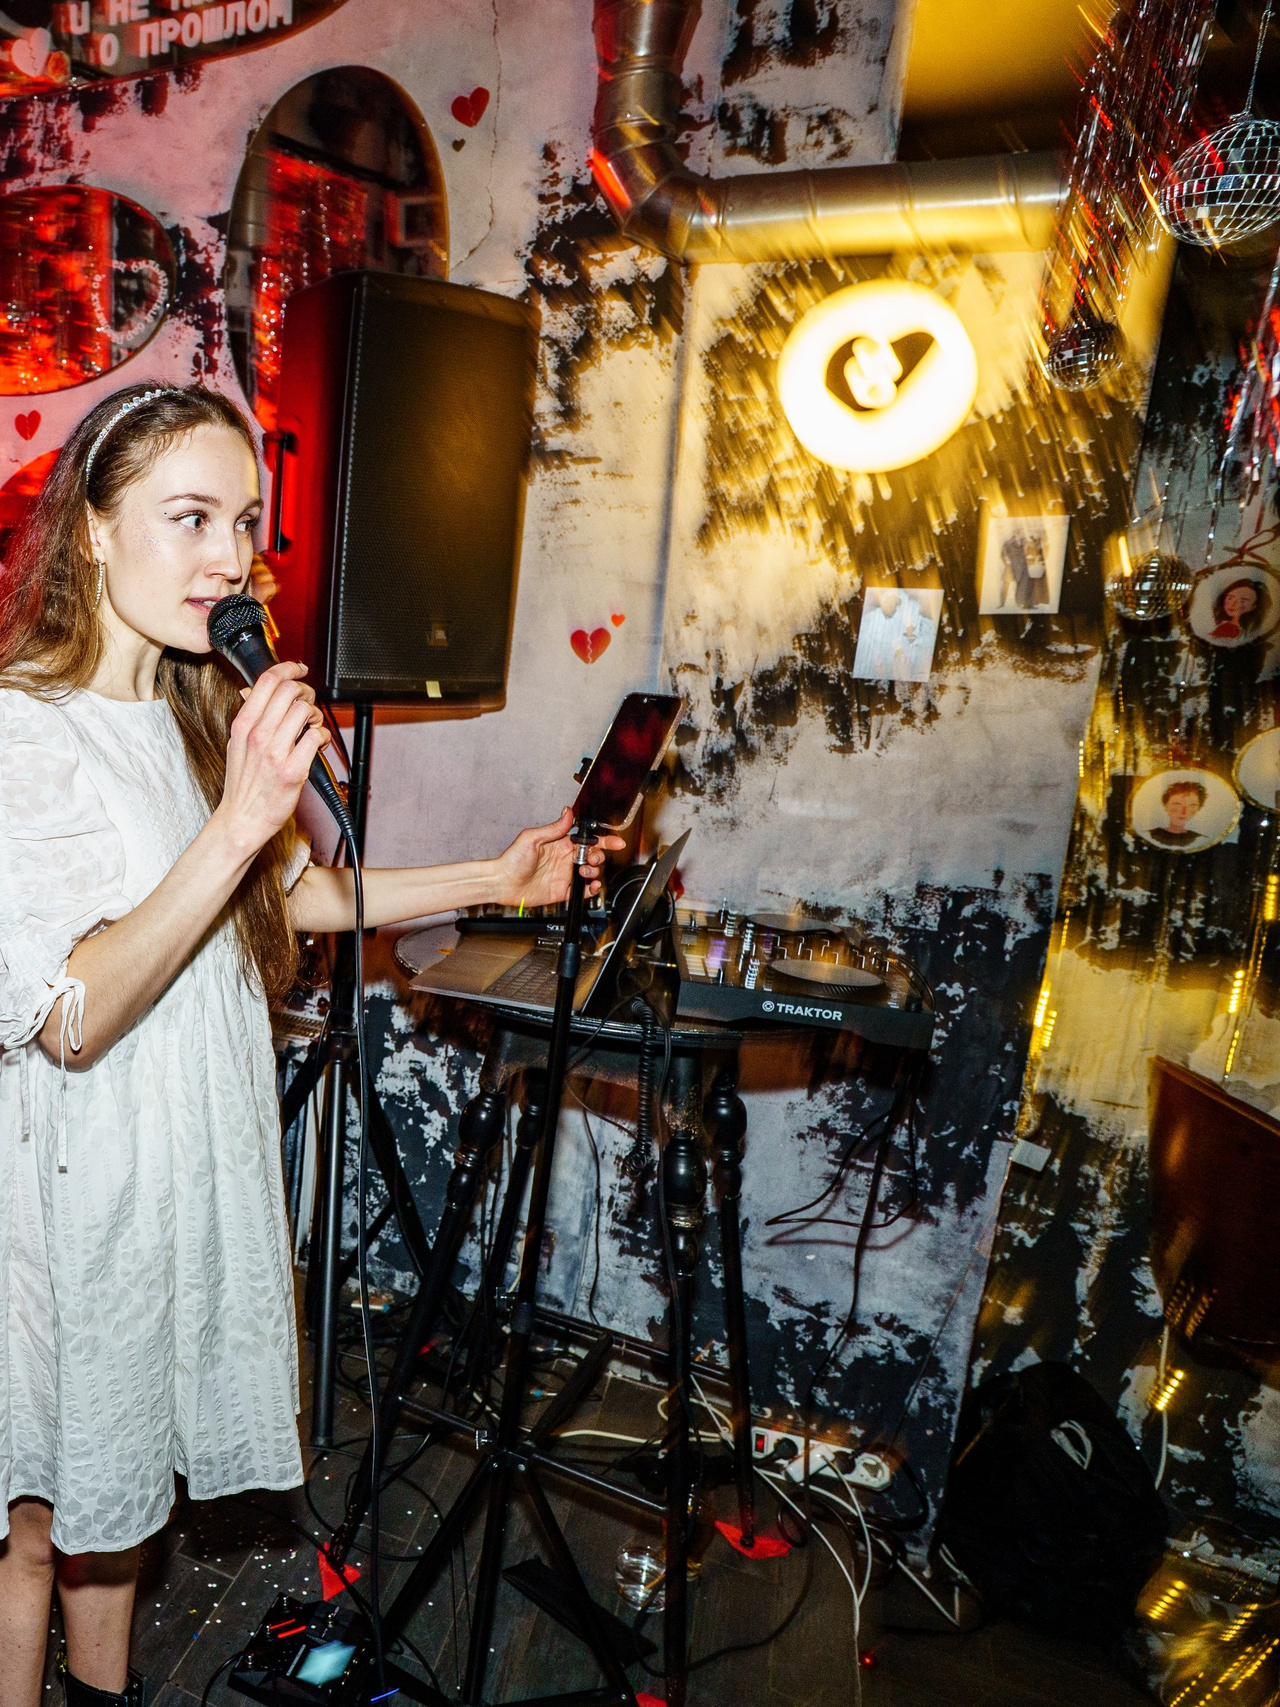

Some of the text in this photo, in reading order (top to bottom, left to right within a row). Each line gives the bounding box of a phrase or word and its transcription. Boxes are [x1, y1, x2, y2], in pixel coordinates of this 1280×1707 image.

[109, 0, 149, 26] НЕ
[100, 0, 293, 67] О ПРОШЛОМ
[777, 1003, 843, 1021] TRAKTOR
